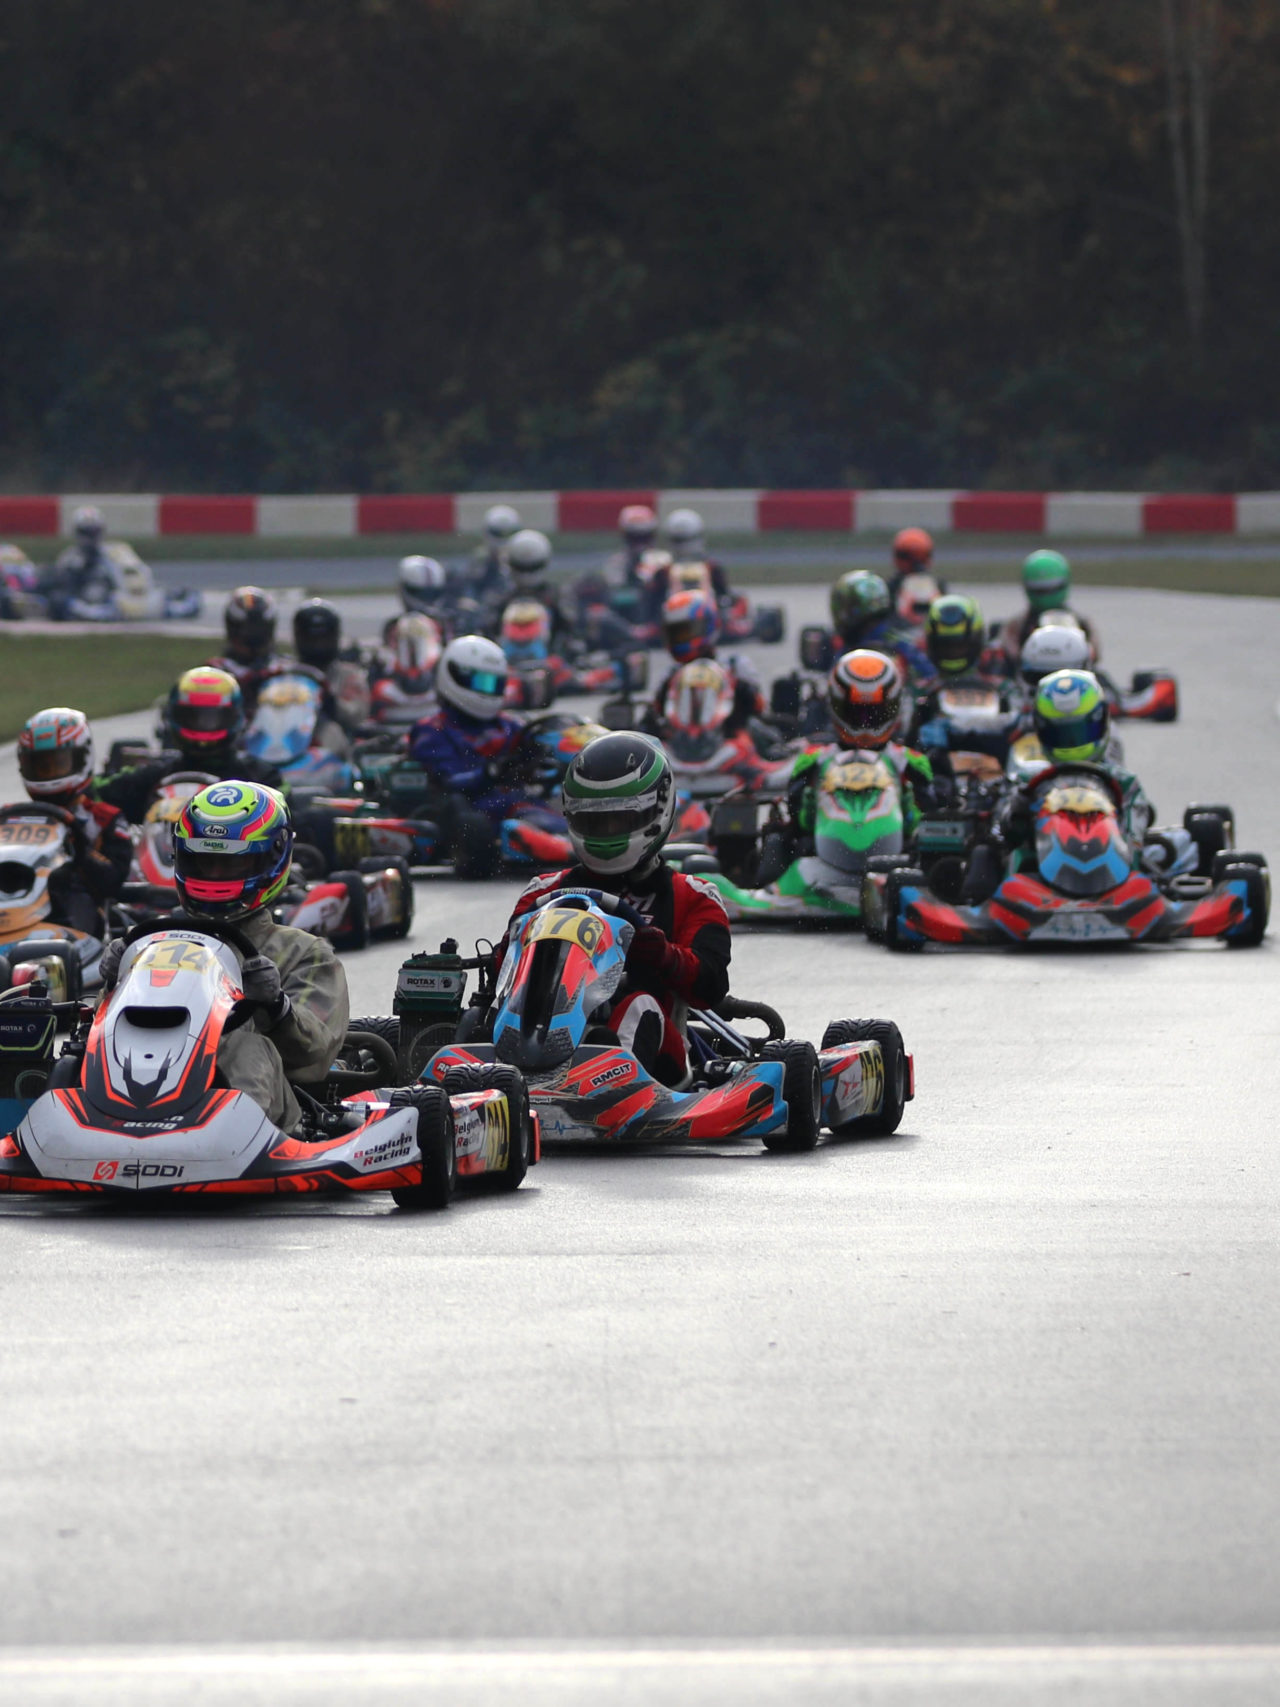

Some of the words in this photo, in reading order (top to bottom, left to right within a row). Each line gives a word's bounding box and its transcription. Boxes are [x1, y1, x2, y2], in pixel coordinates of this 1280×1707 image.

[0, 826, 51, 844] 309
[204, 825, 227, 834] Arai
[169, 932, 208, 941] SODI
[531, 911, 597, 950] 376
[407, 977, 436, 985] ROTAX
[591, 1063, 631, 1086] RMCIT
[111, 1121, 177, 1130] Racing
[354, 1133, 412, 1158] Belgium
[363, 1146, 411, 1166] Racing
[122, 1164, 184, 1177] SODI
